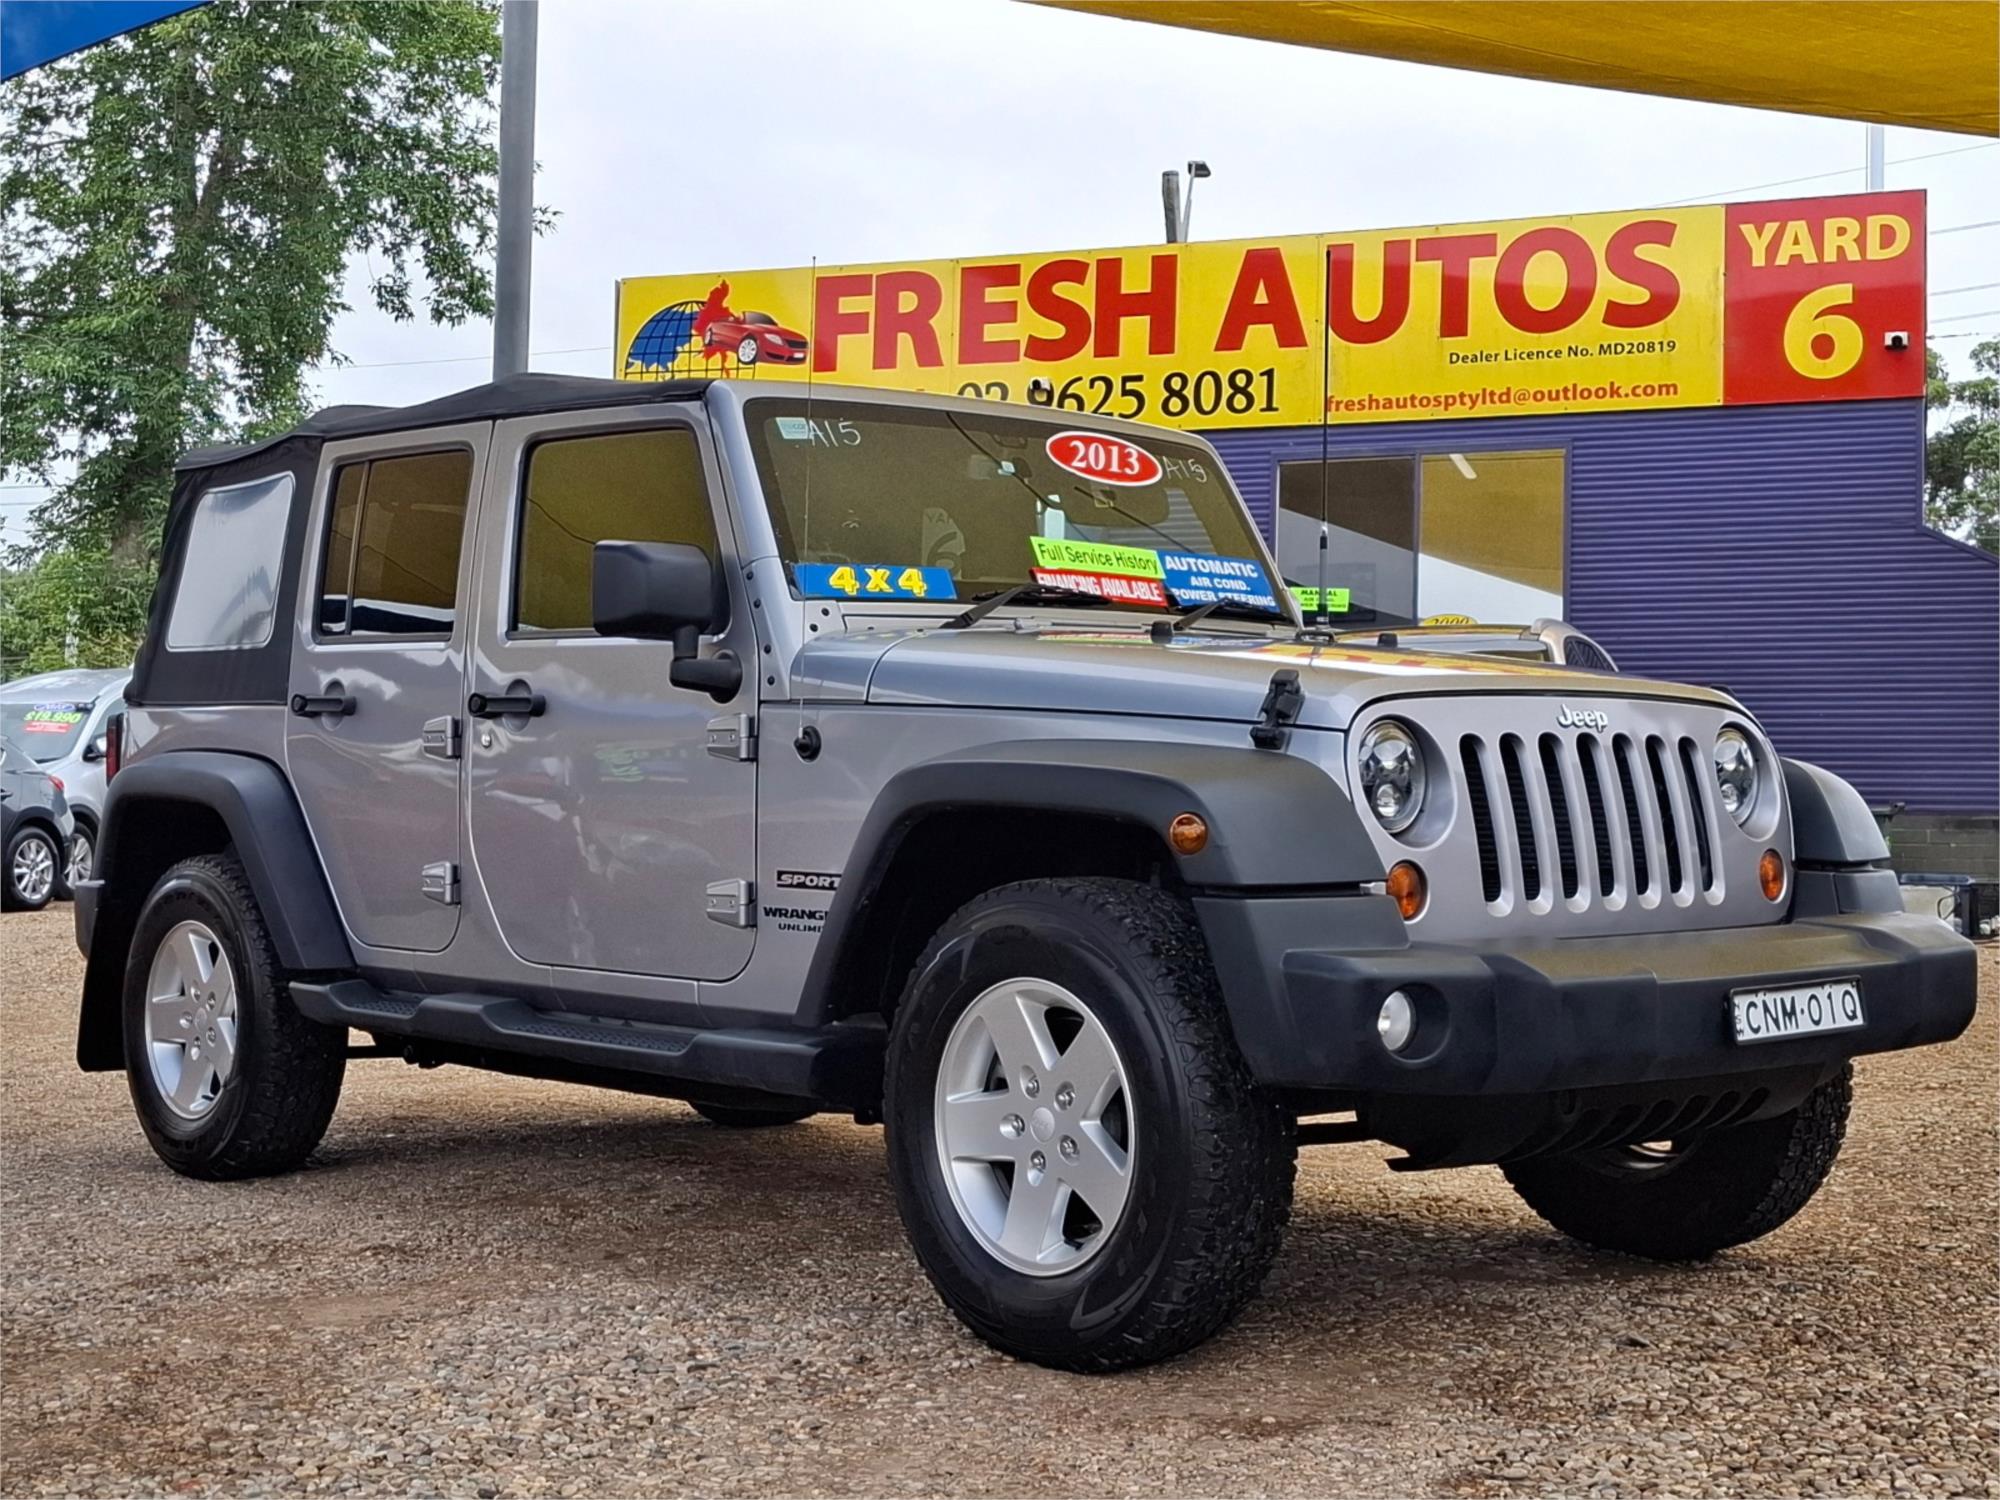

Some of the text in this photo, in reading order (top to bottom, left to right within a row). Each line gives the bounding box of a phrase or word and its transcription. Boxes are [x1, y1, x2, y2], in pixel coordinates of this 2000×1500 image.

[1739, 214, 1910, 267] YARD
[813, 219, 1681, 372] FRESH AUTOS
[1784, 283, 1863, 379] 6
[1449, 340, 1676, 364] Dealer Licence No. MD20819
[1161, 368, 1280, 418] 8081
[1327, 381, 1678, 412] freshautosptyltd@outlook.com
[1070, 440, 1141, 475] 2013
[1038, 544, 1158, 574] Full Service History
[1165, 555, 1258, 577] AUTOMATIC
[1037, 573, 1162, 601] FINANCING AVAILABLE
[1171, 588, 1218, 602] POWER
[1190, 576, 1251, 591] AIR COND.
[1556, 703, 1608, 733] Jeep
[778, 873, 840, 888] SPORT
